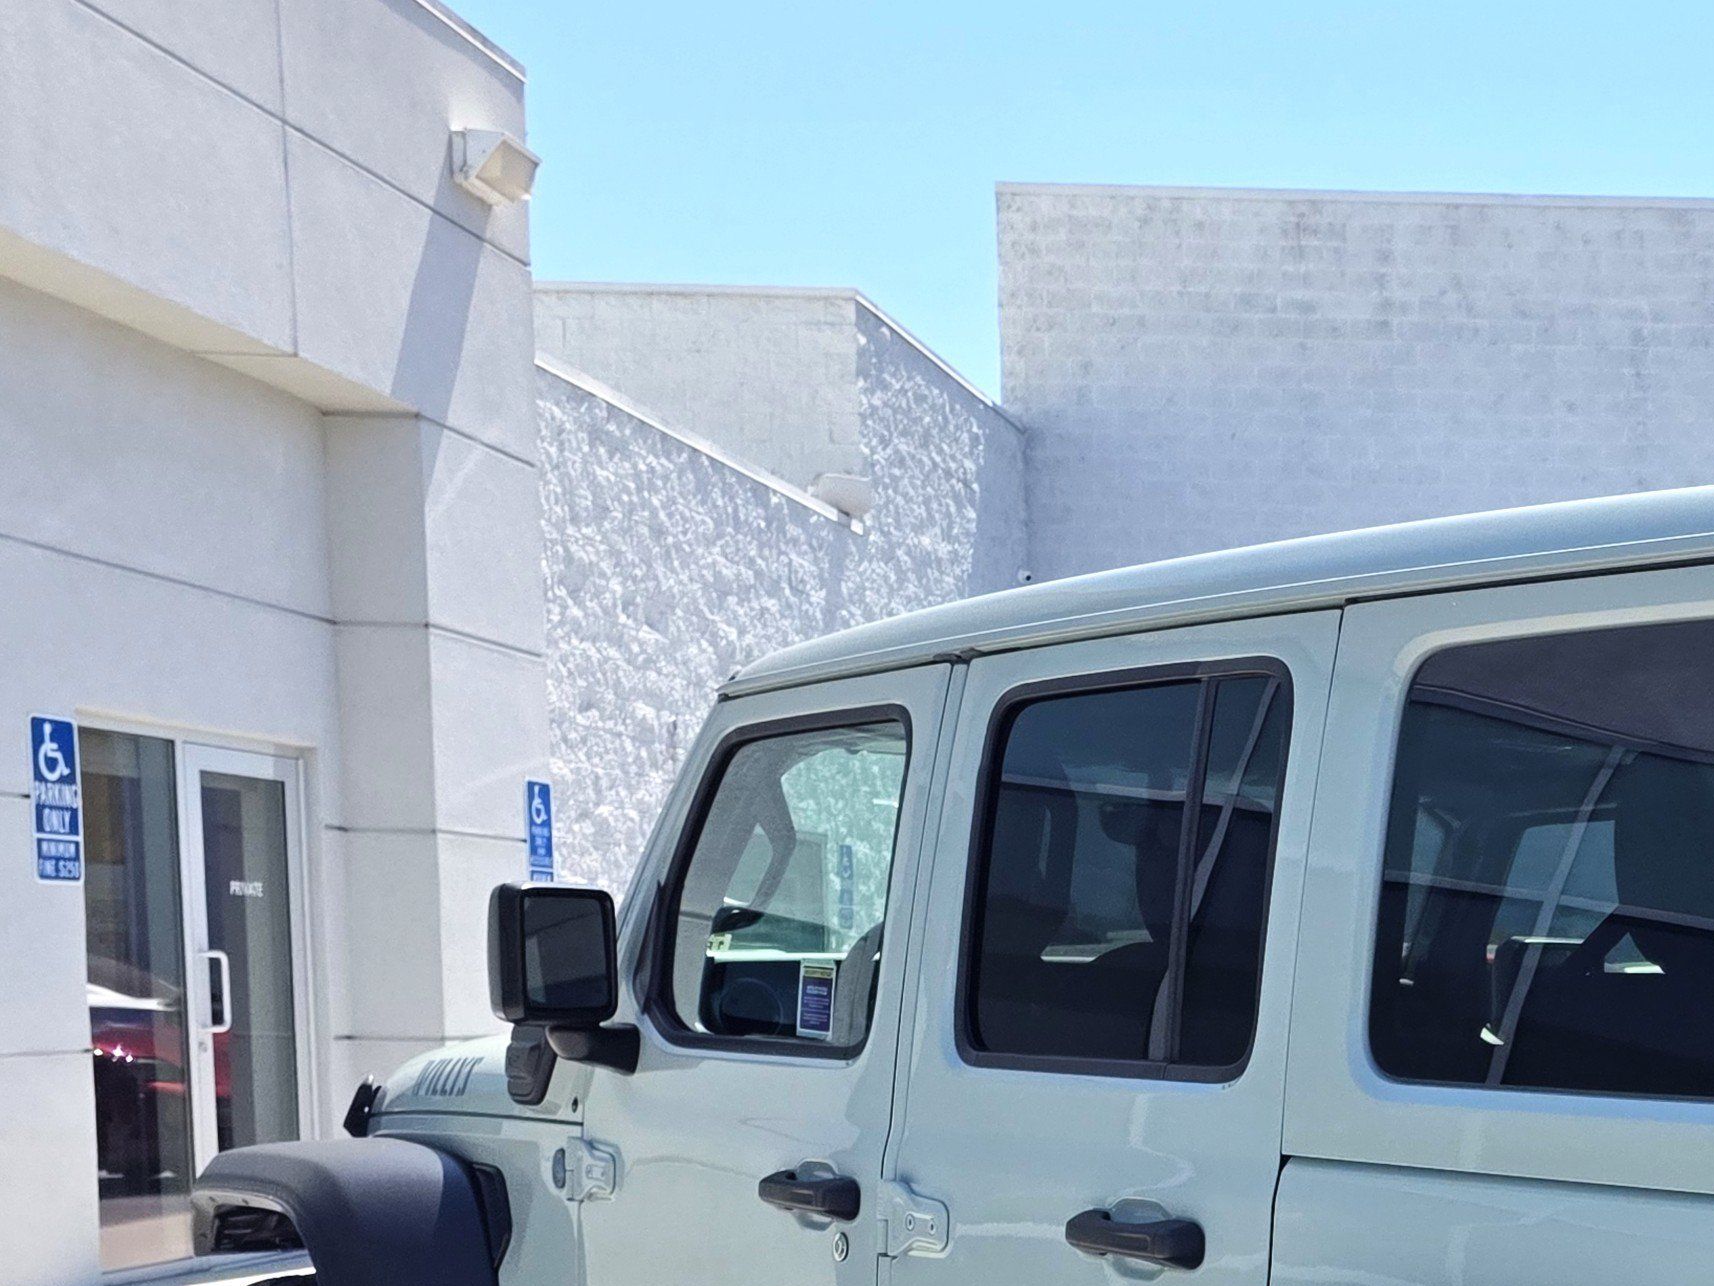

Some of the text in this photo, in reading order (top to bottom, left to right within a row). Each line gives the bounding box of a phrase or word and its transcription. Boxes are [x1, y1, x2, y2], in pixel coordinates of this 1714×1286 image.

[35, 781, 77, 808] PARKING
[43, 808, 71, 833] ONLY
[230, 880, 263, 897] PRIVATE
